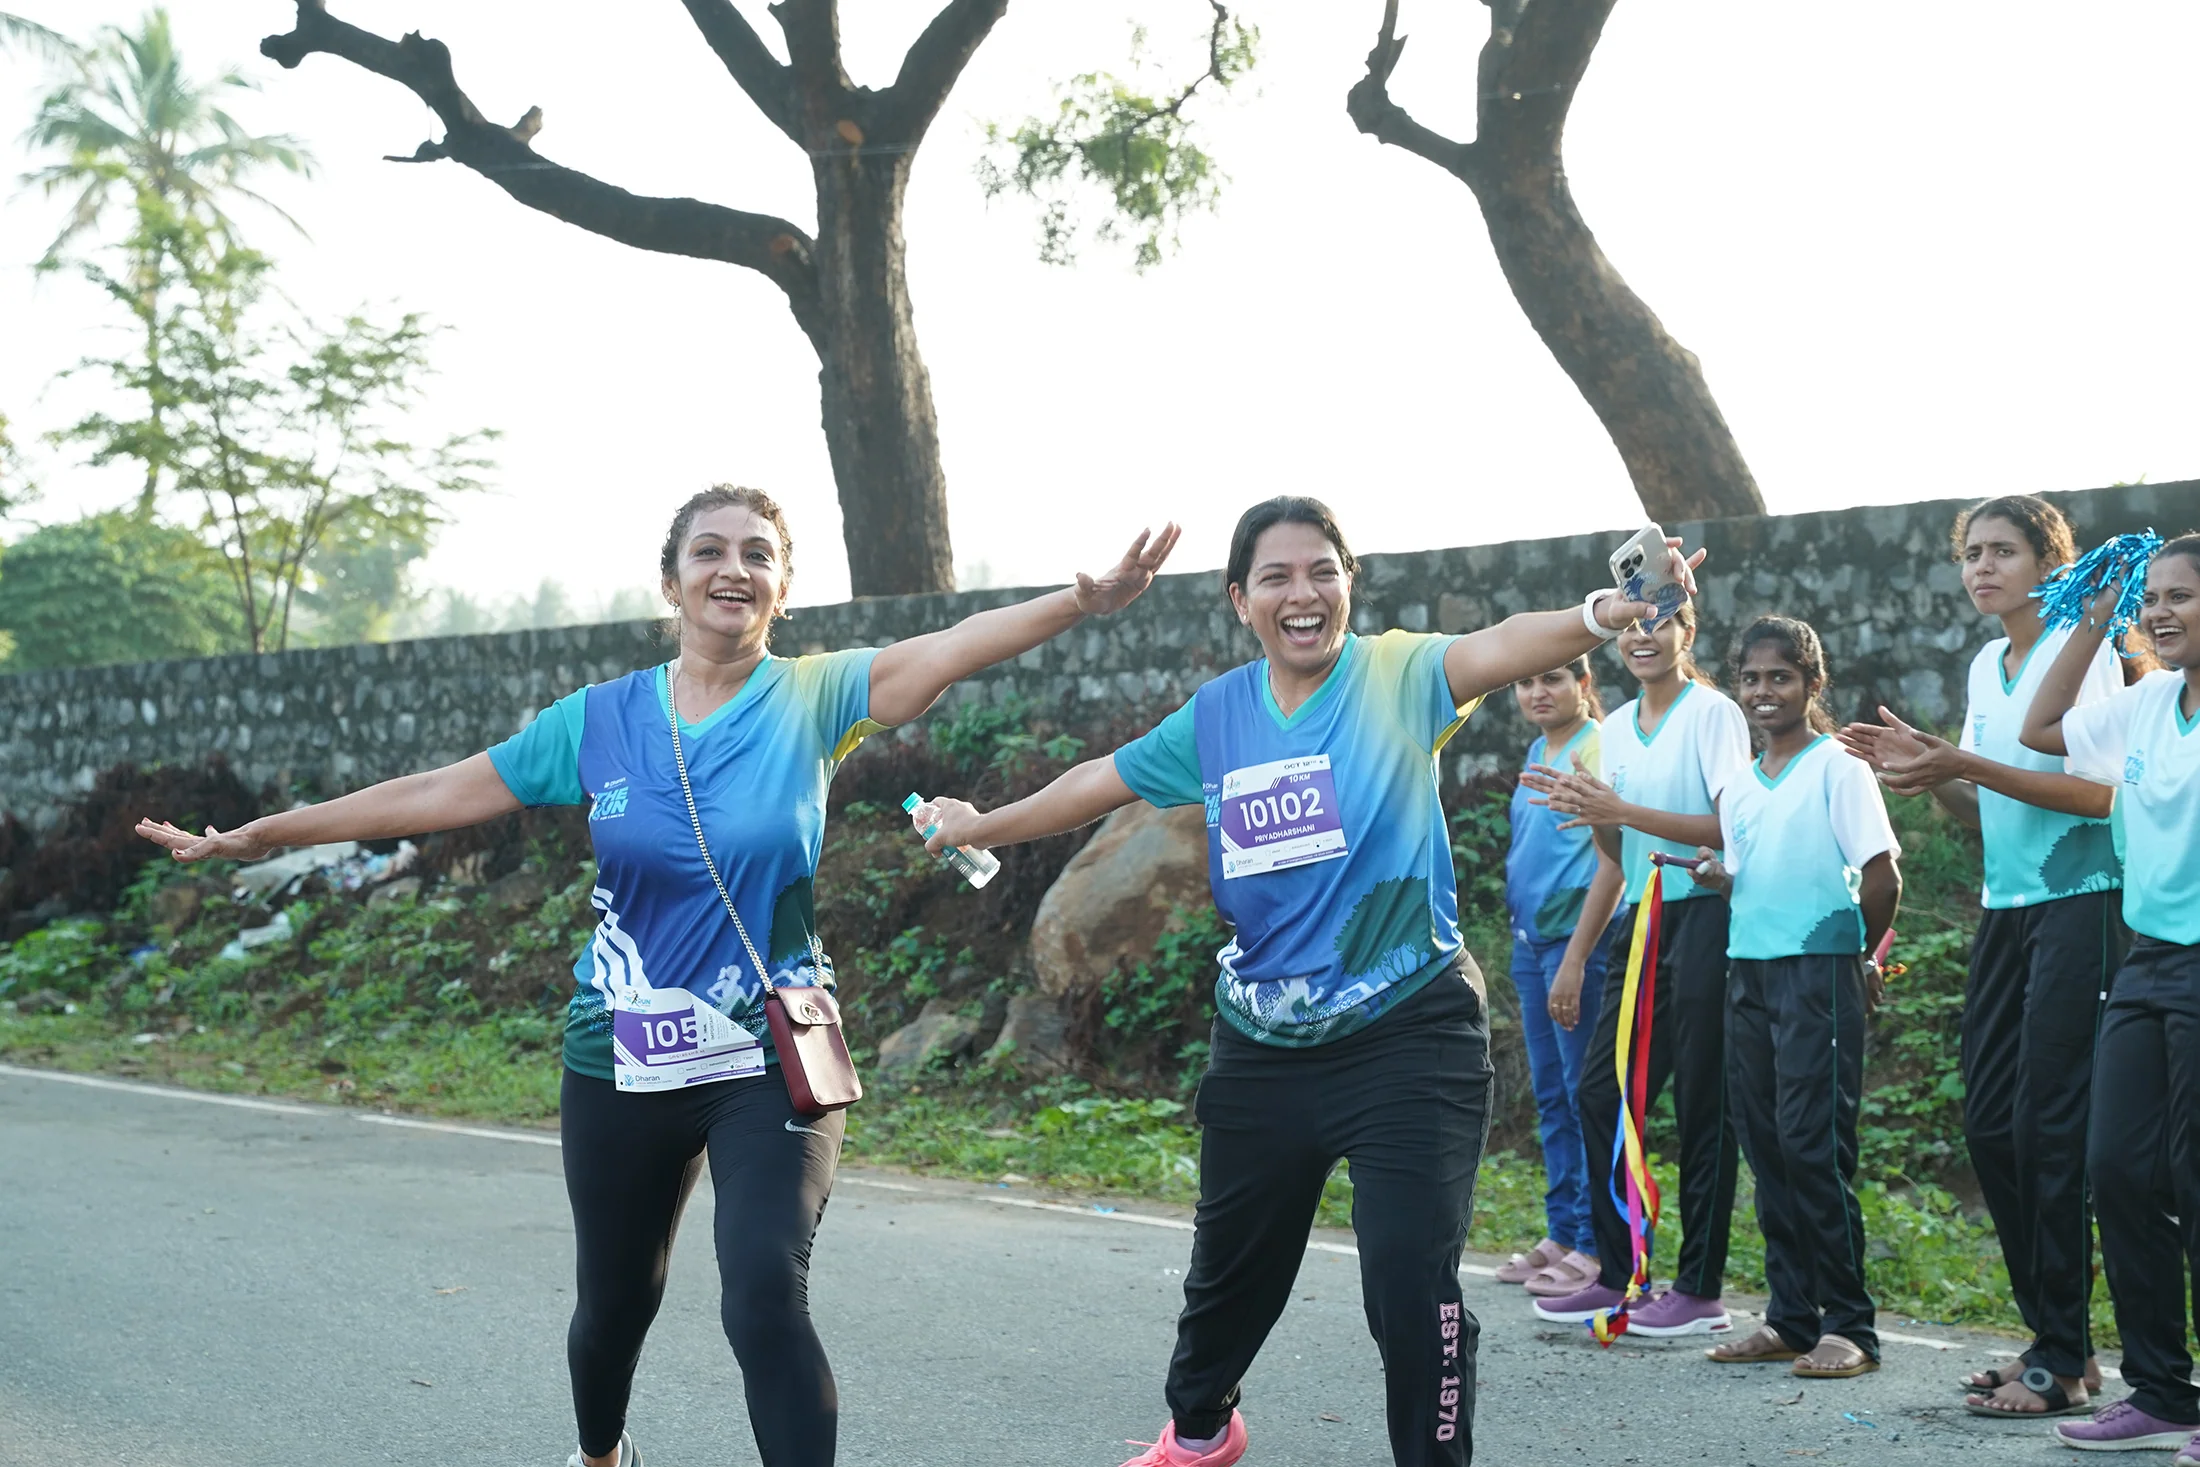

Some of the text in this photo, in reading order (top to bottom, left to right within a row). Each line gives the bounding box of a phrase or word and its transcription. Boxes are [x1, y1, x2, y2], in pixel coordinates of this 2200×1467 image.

[1284, 762, 1301, 770] OCT
[1289, 773, 1311, 783] 10 KM
[595, 786, 629, 803] THE
[1240, 787, 1324, 830] 10102
[1254, 824, 1316, 843] PRIYADHARSHANI
[635, 1074, 661, 1082] Dharan
[1435, 1302, 1461, 1442] EST. 1970
